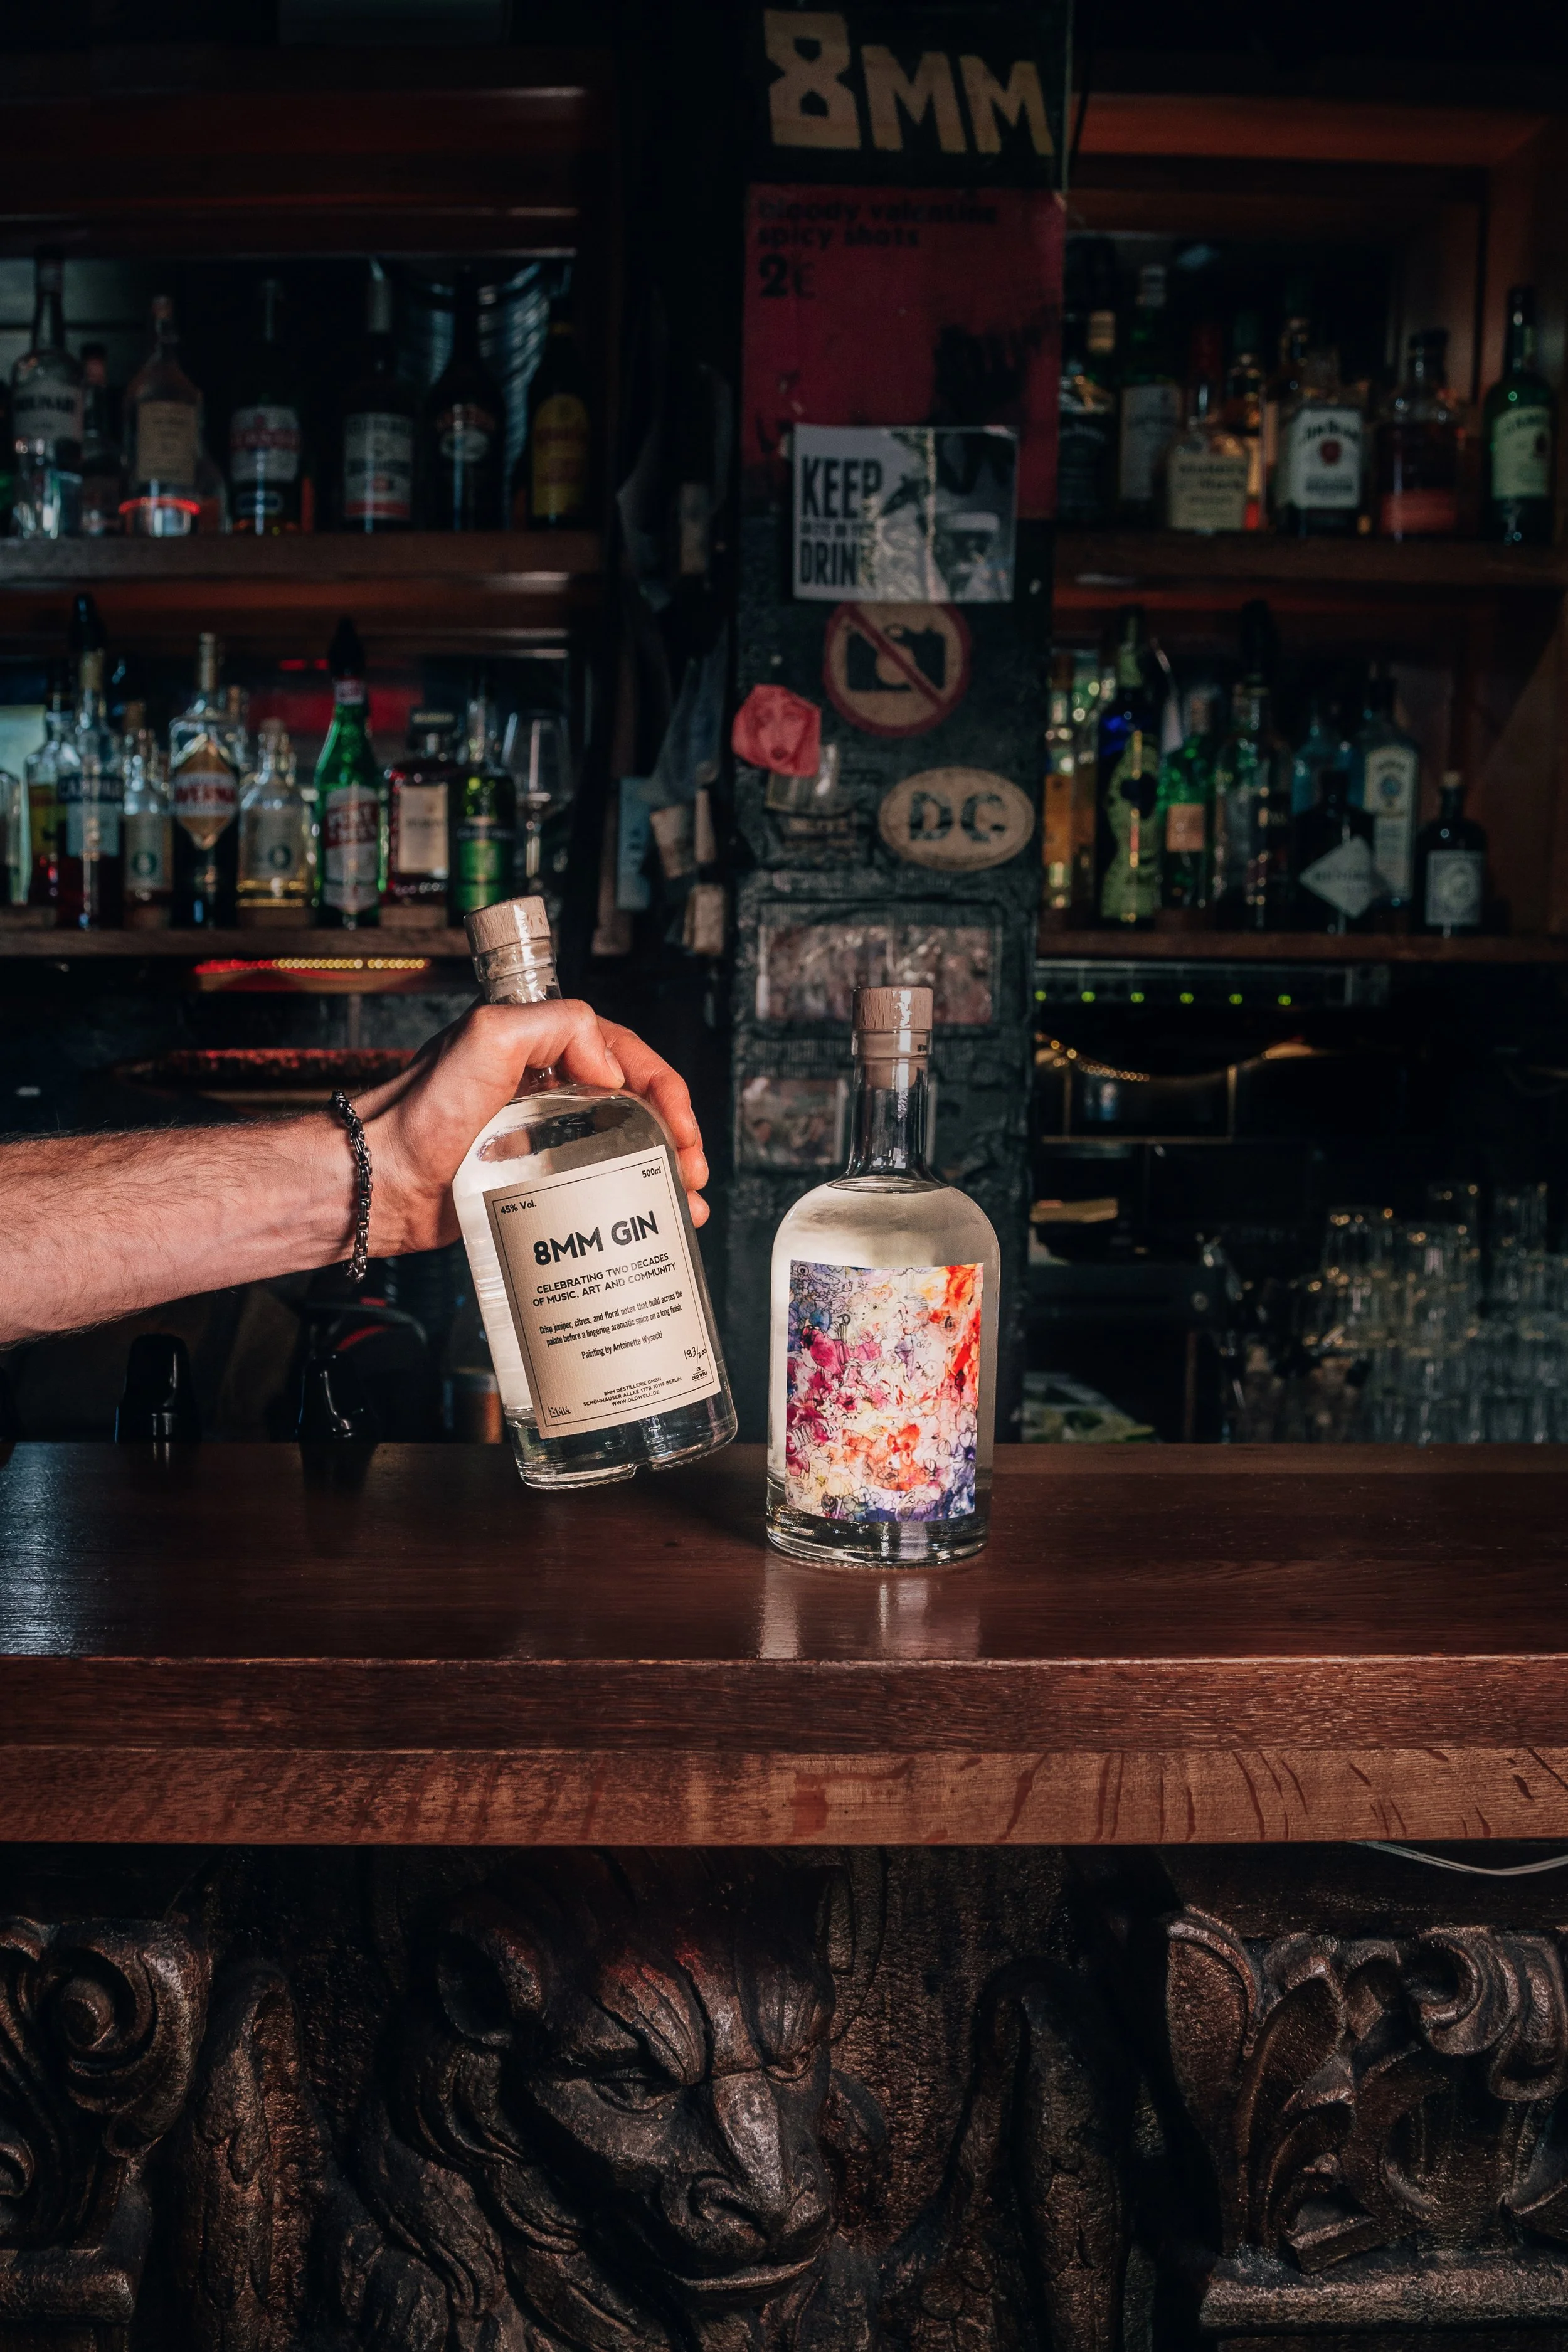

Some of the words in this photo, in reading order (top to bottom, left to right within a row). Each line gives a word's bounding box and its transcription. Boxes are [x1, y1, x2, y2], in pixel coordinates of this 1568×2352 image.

[764, 10, 1054, 156] 8MM
[759, 199, 861, 221] bloody
[871, 203, 997, 224] valentine
[758, 226, 832, 249] spicy
[845, 226, 919, 247] shots
[802, 455, 882, 518] KEEP
[642, 1166, 661, 1178] 500ml
[501, 1204, 518, 1214] 45%
[519, 1199, 537, 1210] Vol.
[533, 1226, 603, 1266] 8MM
[611, 1210, 659, 1246] GIN
[533, 1298, 544, 1307] OF
[547, 1291, 579, 1305] MUSIC,
[582, 1284, 601, 1296] ART
[605, 1278, 625, 1291] AND
[628, 1262, 675, 1283] COMMUNITY
[536, 1271, 603, 1294] CELEBRATING
[605, 1265, 628, 1278] TWO
[631, 1253, 669, 1271] DECADES
[539, 1325, 553, 1334] Crisp
[553, 1321, 573, 1333] juniper,
[574, 1316, 591, 1328] citrus,
[593, 1313, 603, 1322] and
[605, 1309, 619, 1320] floral
[621, 1306, 636, 1316] notes
[637, 1301, 648, 1311] that
[649, 1296, 660, 1307] build
[661, 1294, 675, 1303] across
[546, 1336, 563, 1347] palate
[563, 1330, 581, 1343] before
[586, 1327, 611, 1338] lingering
[611, 1318, 635, 1332] aromatic
[636, 1314, 649, 1325] spice
[650, 1313, 656, 1321] on
[660, 1307, 670, 1318] long
[670, 1304, 682, 1315] finish.
[581, 1347, 605, 1359] Painting
[605, 1345, 612, 1355] by
[613, 1339, 641, 1352] Antoinette
[641, 1330, 662, 1345] Wysocki
[583, 1393, 622, 1407] SCHÖNHAUSER
[623, 1389, 640, 1397] ALLEE
[665, 1376, 682, 1385] BERLIN
[611, 1390, 660, 1406] WWW.OLDWELL.DE
[616, 1381, 647, 1394] DESTILLERIE
[647, 1377, 662, 1385] GMBH
